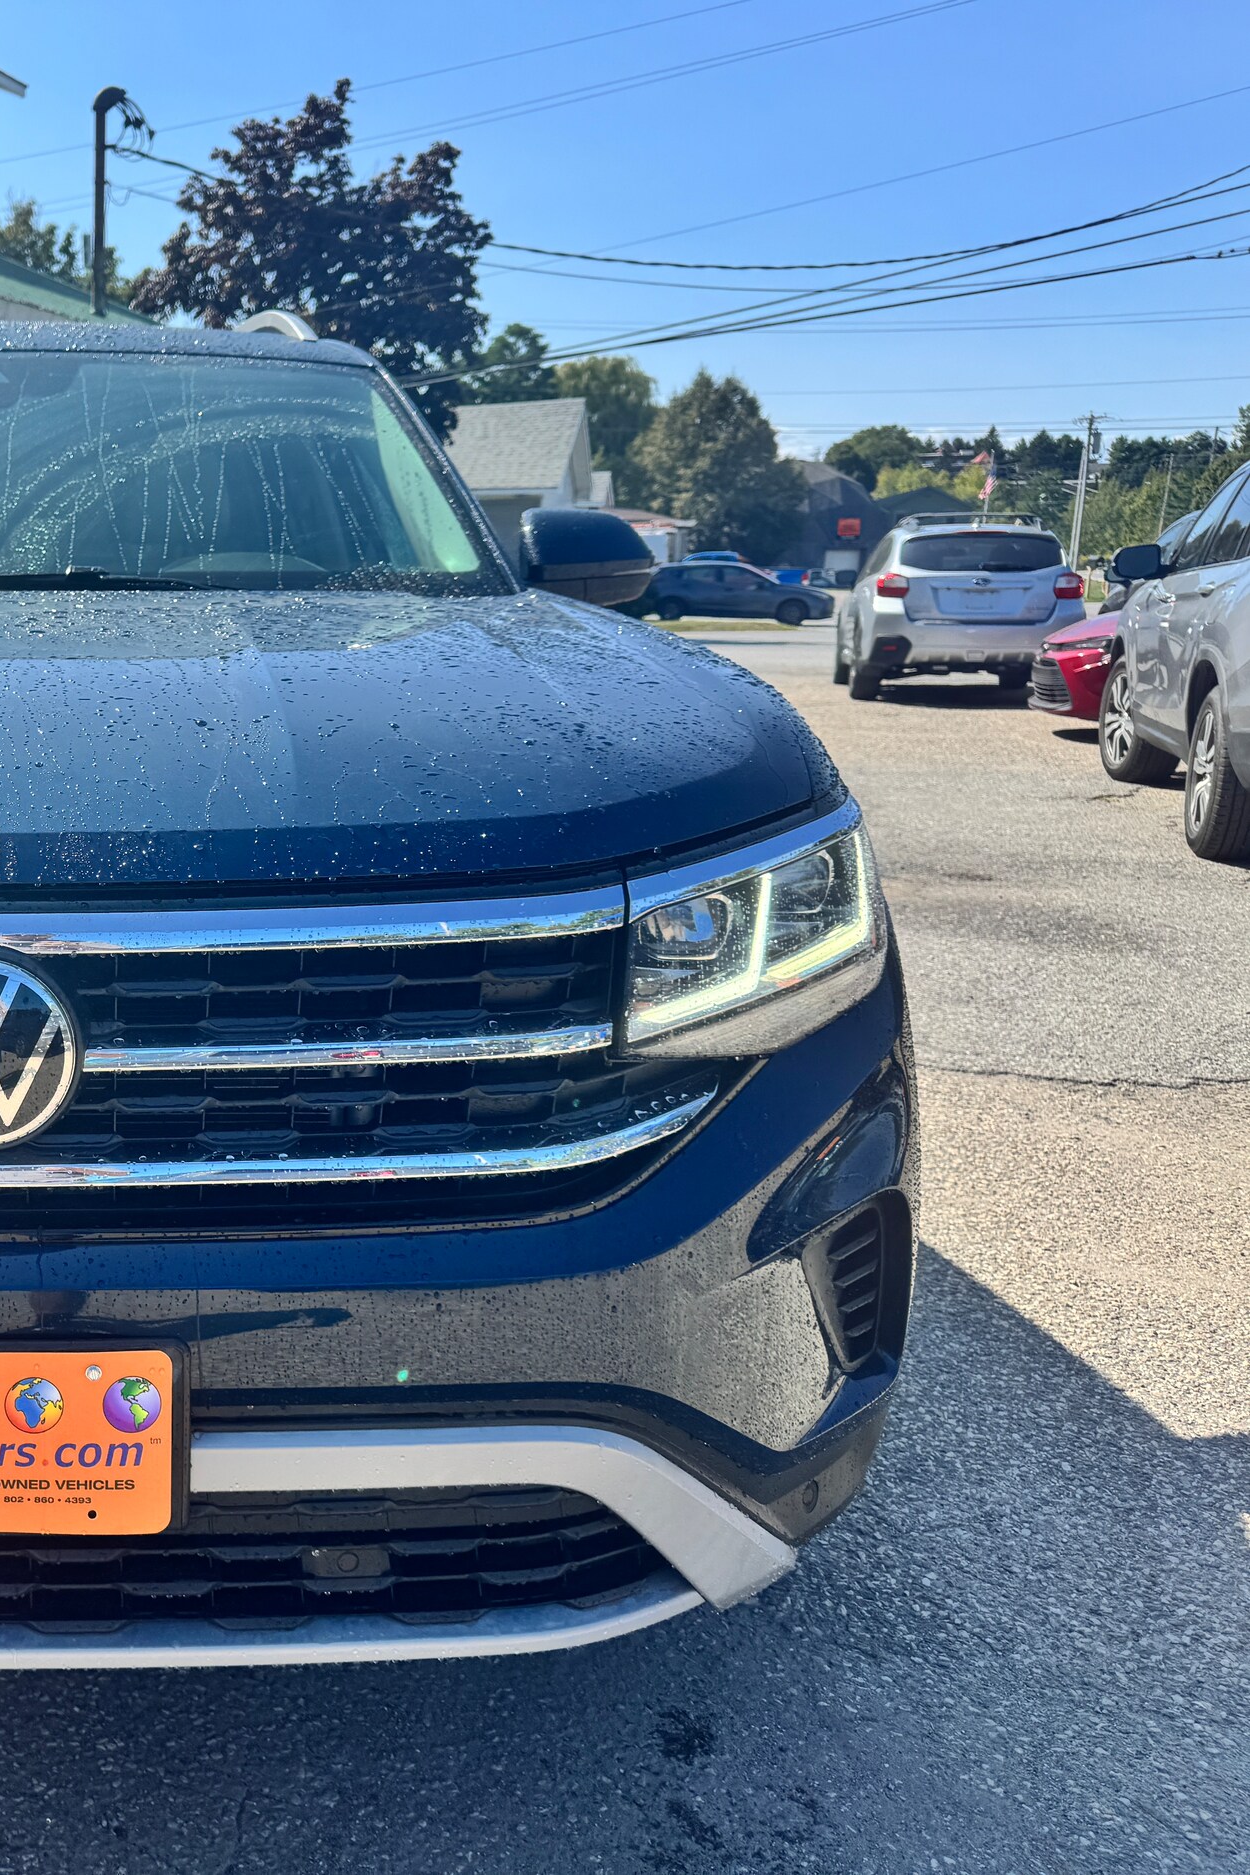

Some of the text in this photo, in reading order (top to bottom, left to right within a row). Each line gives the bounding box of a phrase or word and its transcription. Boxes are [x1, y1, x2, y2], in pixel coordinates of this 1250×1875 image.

[54, 1479, 136, 1491] VEHICLES
[3, 1495, 25, 1503] 802
[33, 1496, 55, 1504] 860
